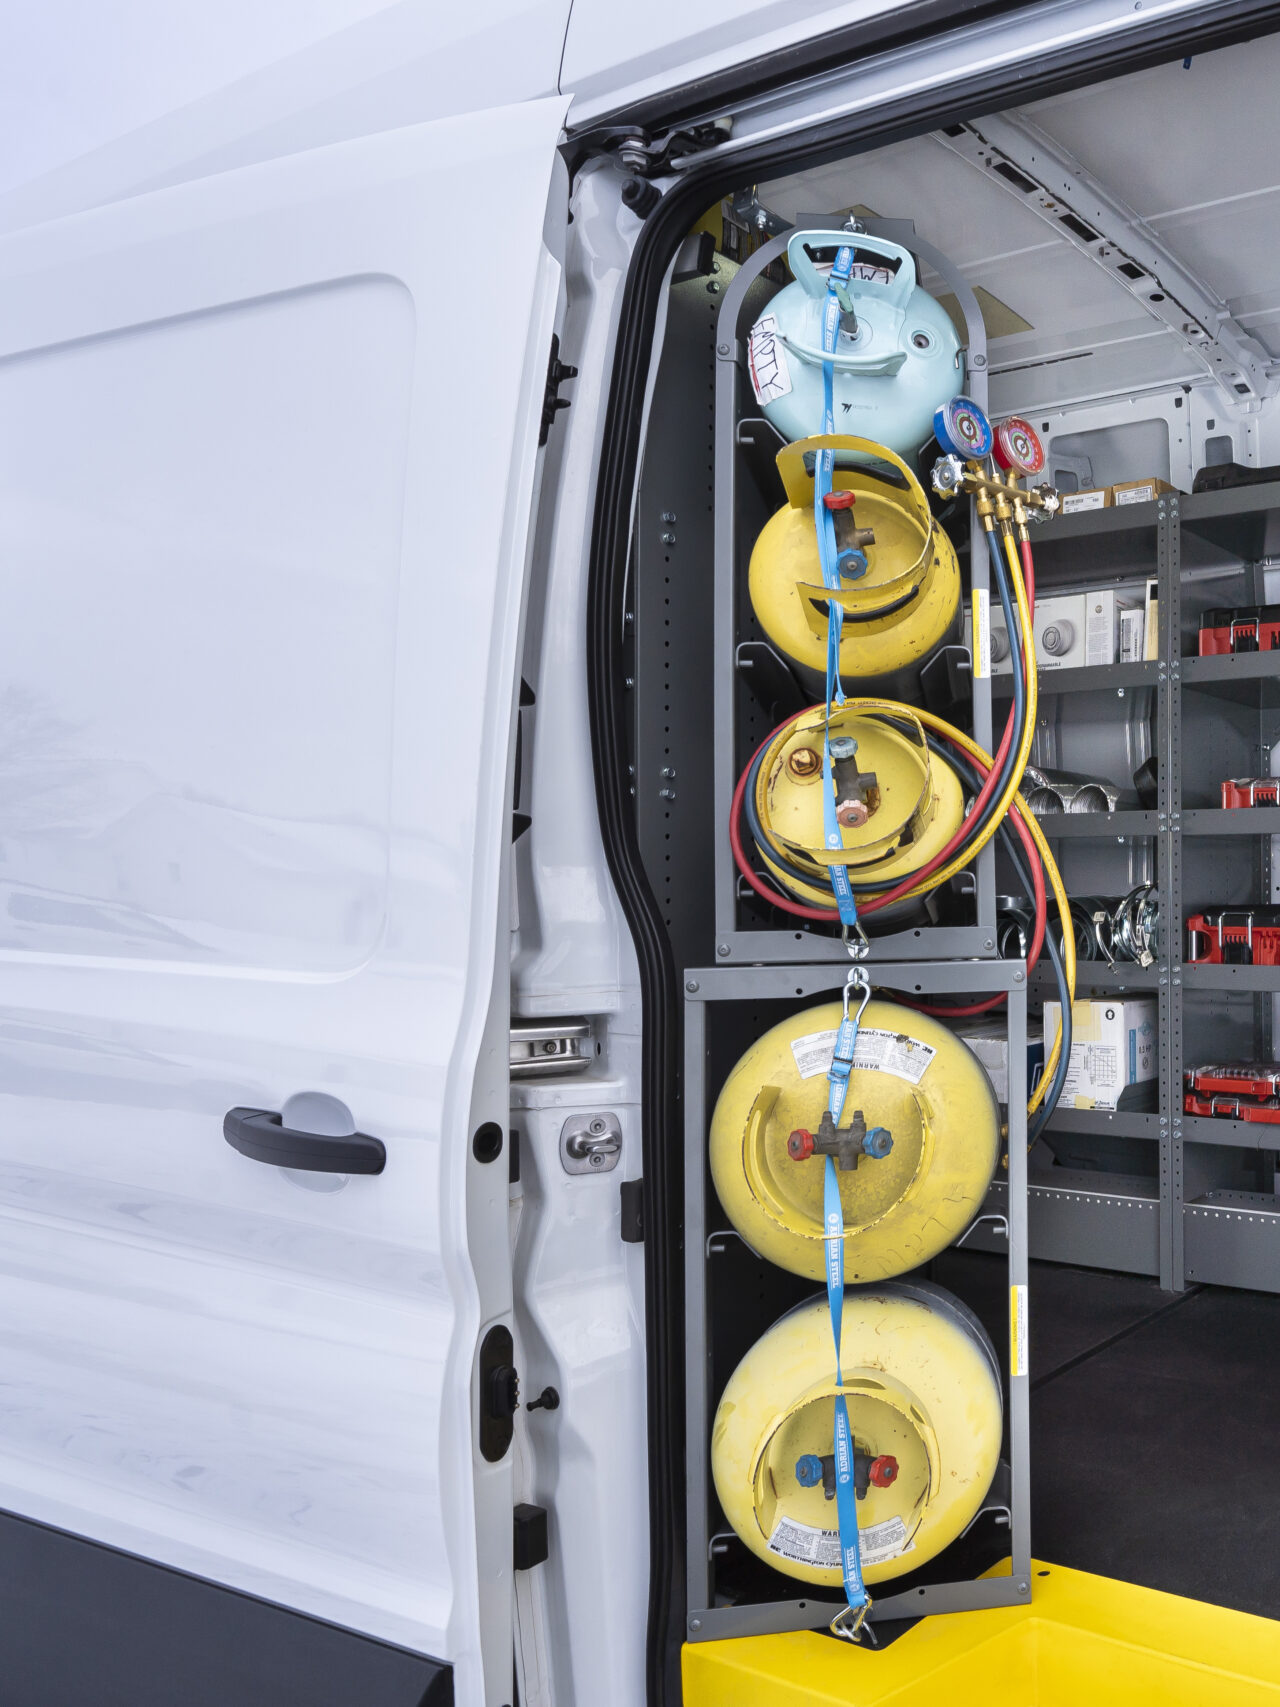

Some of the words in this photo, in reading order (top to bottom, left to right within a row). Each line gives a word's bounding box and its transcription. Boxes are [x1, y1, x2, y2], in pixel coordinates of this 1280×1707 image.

[752, 317, 784, 391] EMPTY
[853, 1062, 880, 1070] WARNIN
[831, 1261, 839, 1289] STEEL
[837, 1412, 846, 1439] STEEL
[839, 1440, 847, 1472] ADRIAN
[847, 1547, 855, 1570] STEEL
